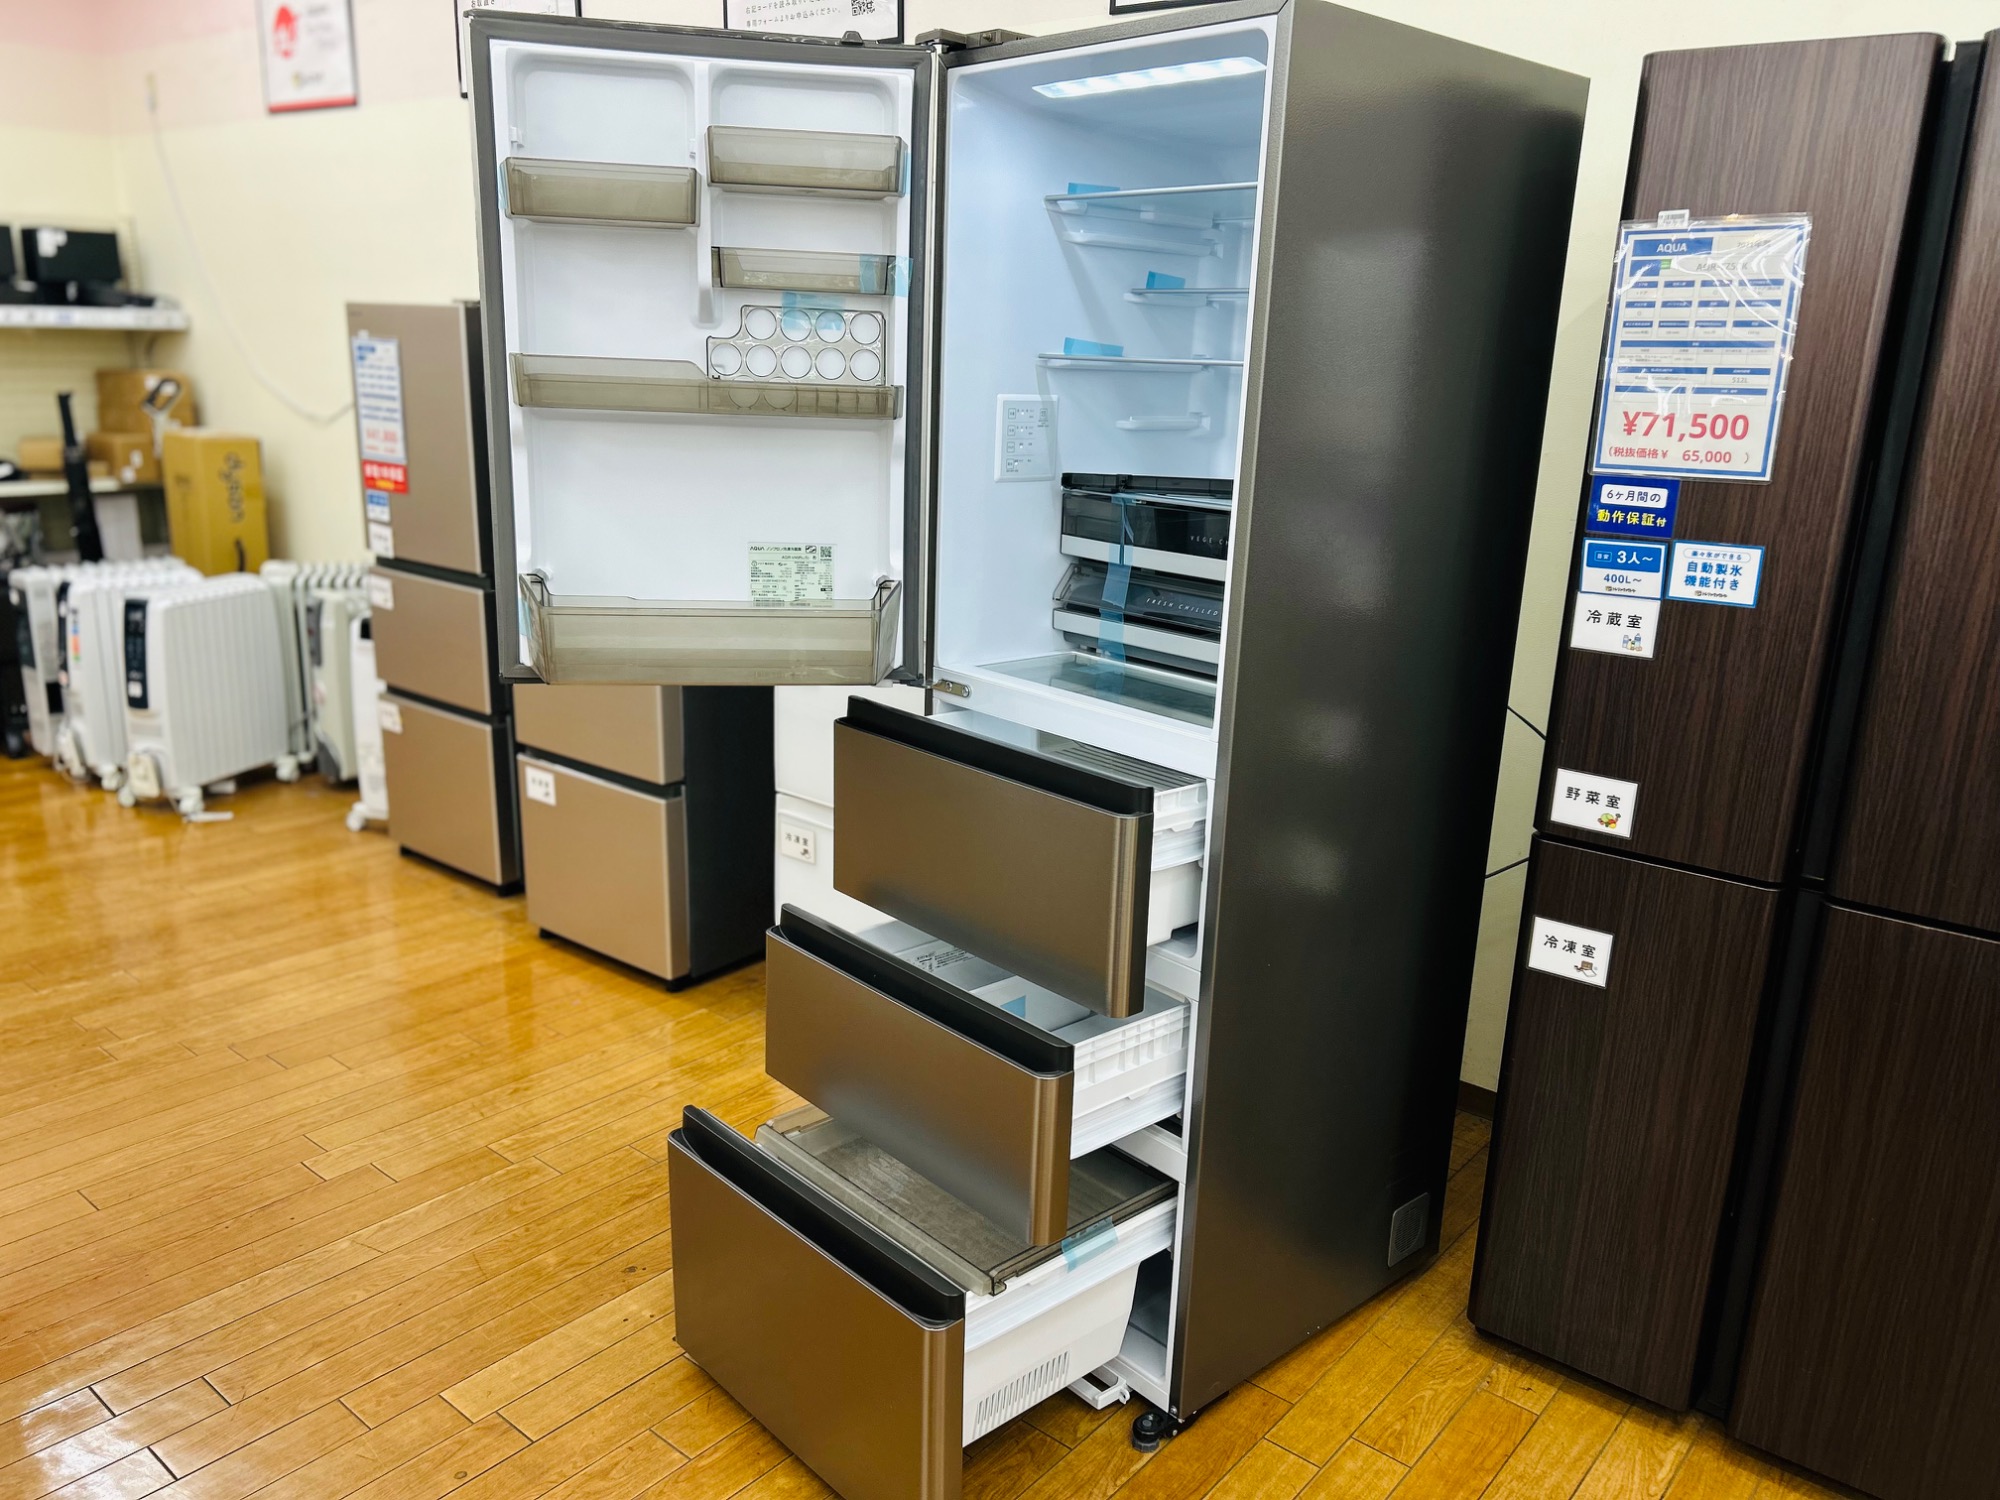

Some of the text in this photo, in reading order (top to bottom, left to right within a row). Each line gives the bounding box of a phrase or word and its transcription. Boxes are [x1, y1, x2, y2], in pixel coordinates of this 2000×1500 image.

[1656, 242, 1688, 253] AQUA
[1623, 410, 1750, 443] ¥71,500
[1682, 451, 1732, 464] 65,000
[1596, 509, 1667, 528] 動作保証付
[1190, 536, 1213, 544] VEGE
[1687, 560, 1743, 577] 自動製氷
[1684, 575, 1740, 591] 機能付き
[1146, 598, 1218, 616] FRESH CHILLED
[1586, 609, 1643, 629] 冷蔵室
[1565, 786, 1622, 810] 野菜室
[1543, 934, 1597, 960] 冷凍室
